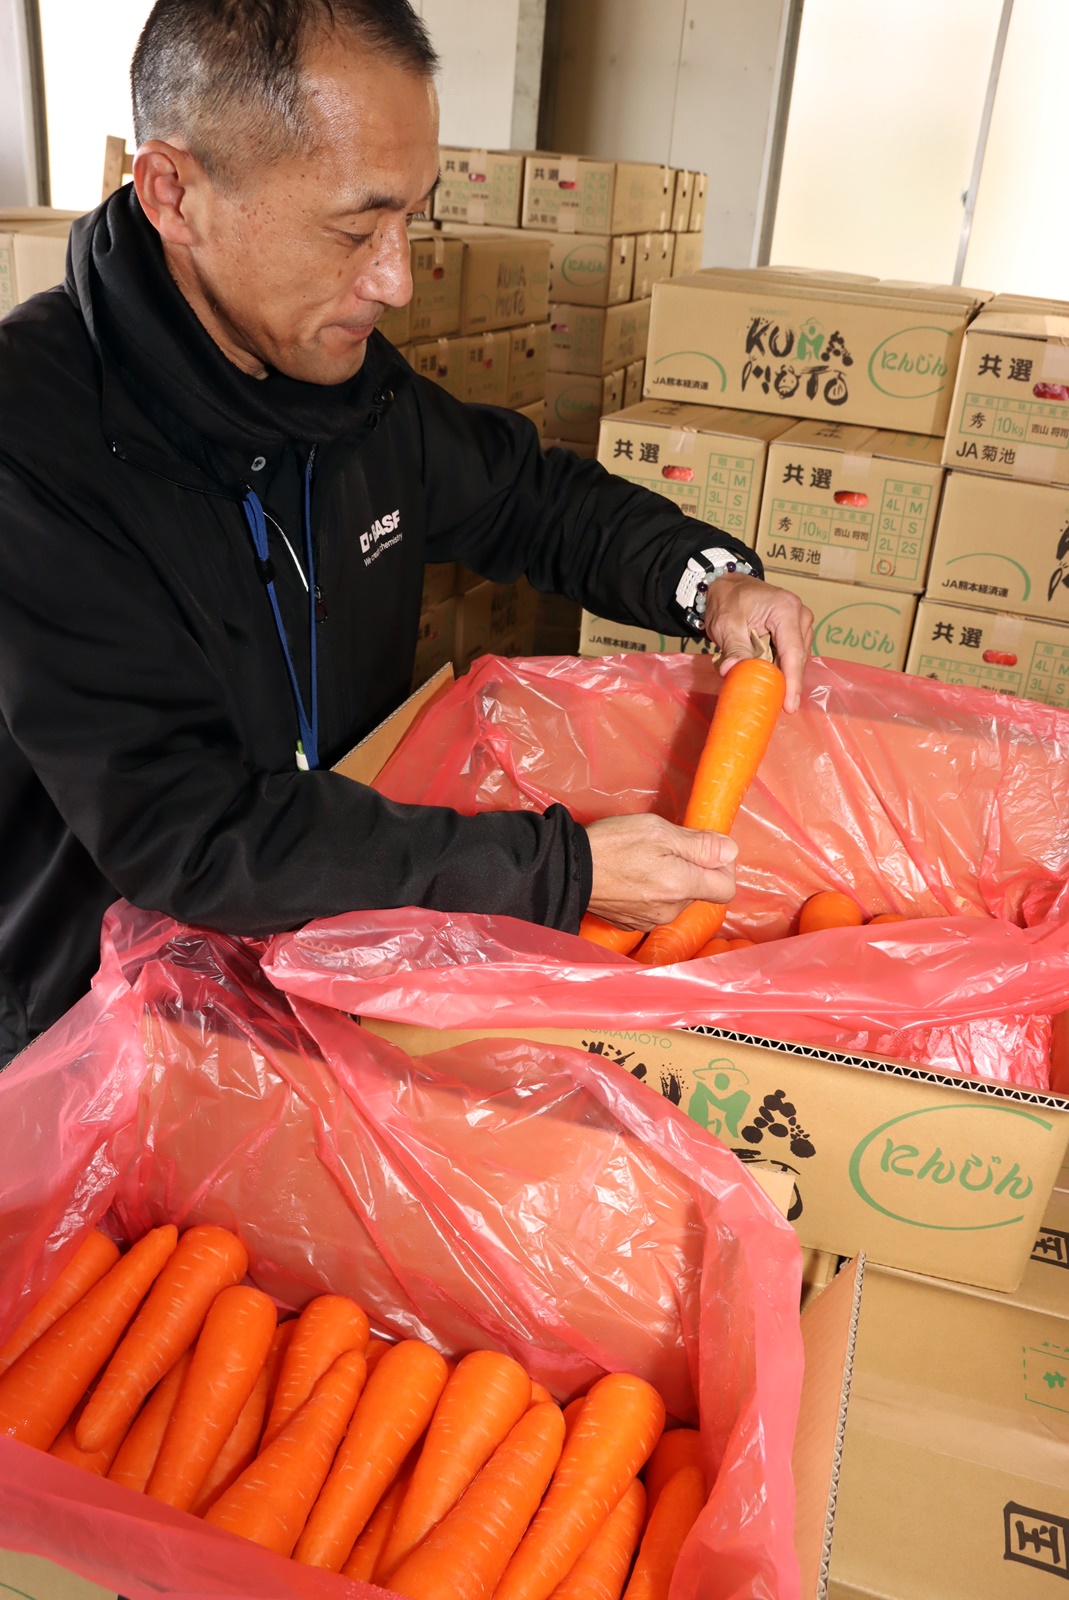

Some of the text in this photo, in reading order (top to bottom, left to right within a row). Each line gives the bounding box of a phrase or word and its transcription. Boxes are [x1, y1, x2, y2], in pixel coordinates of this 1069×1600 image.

[745, 316, 854, 367] KUMA
[879, 349, 949, 378] にんじん
[978, 353, 1034, 382] 共選
[968, 412, 987, 429] 秀
[997, 416, 1025, 438] 10kg
[613, 439, 660, 463] 共選
[711, 469, 747, 487] 4L M
[782, 463, 833, 489] 共選
[709, 490, 743, 507] 3L S
[886, 499, 923, 515] 4L M
[706, 511, 743, 527] 2L 2S
[777, 517, 793, 532] 秀
[803, 521, 828, 540] 10kg
[883, 518, 897, 532] 3L
[908, 525, 918, 537] S
[879, 539, 918, 555] 2L 2S
[941, 579, 1009, 597] JA熊本経済連
[825, 624, 895, 655] にんじん
[931, 621, 983, 648] 共選
[1034, 659, 1049, 673] 4L
[1030, 678, 1045, 692] 3L
[1056, 682, 1066, 695] S
[878, 1138, 1033, 1200] にんじん
